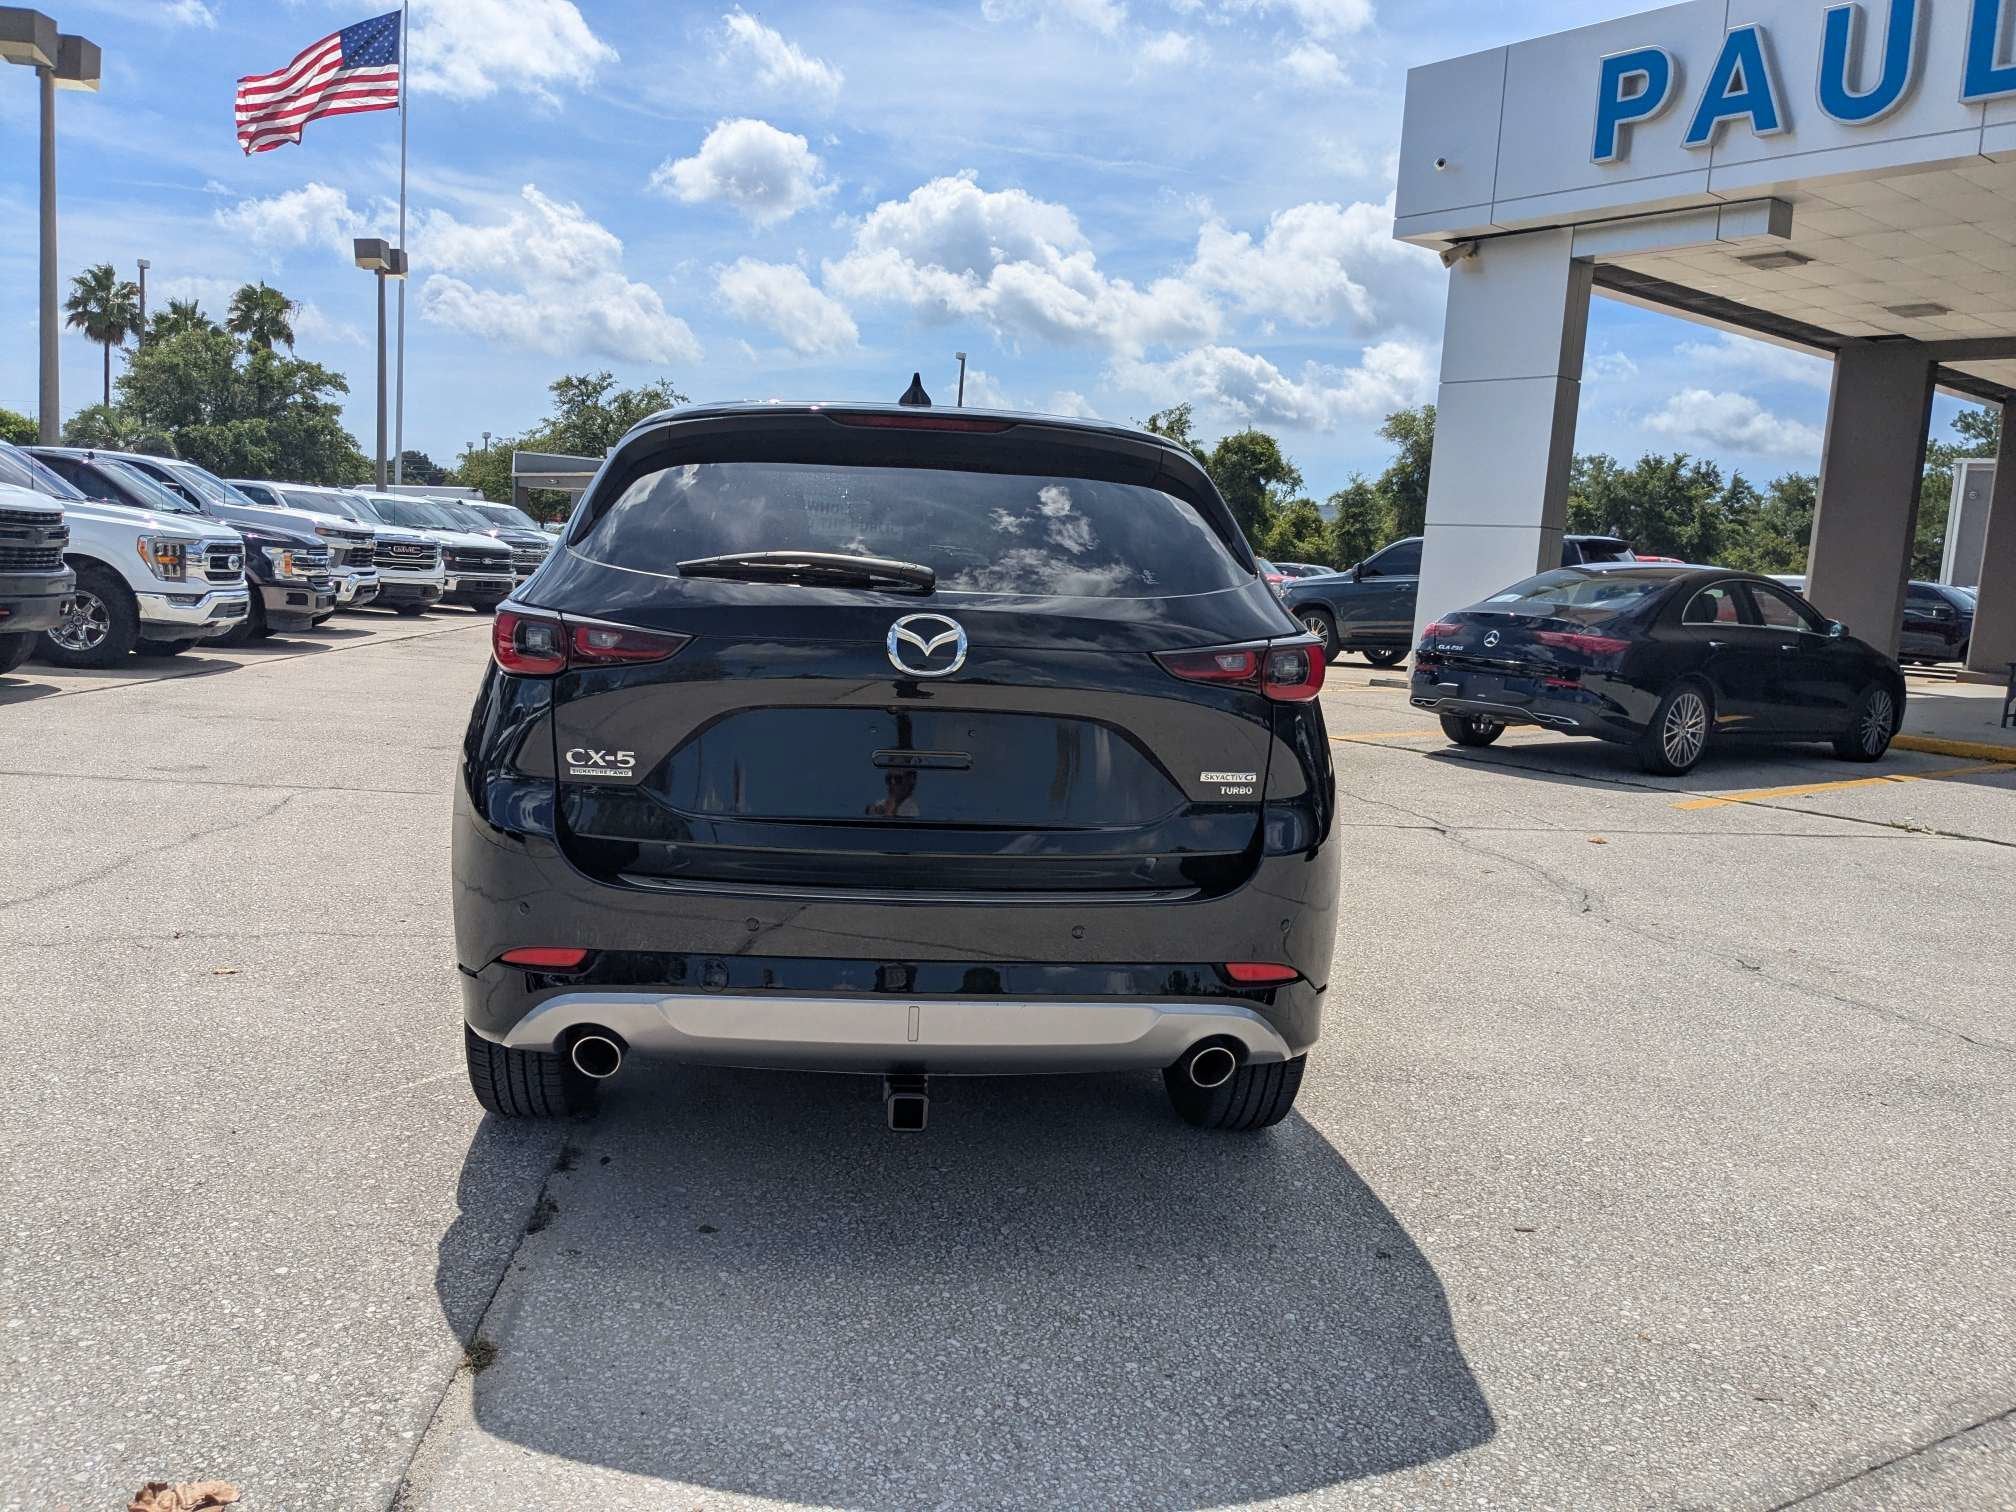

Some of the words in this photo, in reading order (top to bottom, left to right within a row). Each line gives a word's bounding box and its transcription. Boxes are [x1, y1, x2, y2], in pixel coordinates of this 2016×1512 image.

[1589, 0, 2016, 165] PAUL
[393, 545, 421, 553] GMC
[565, 748, 636, 767] CX-5
[1220, 785, 1253, 795] TURBO
